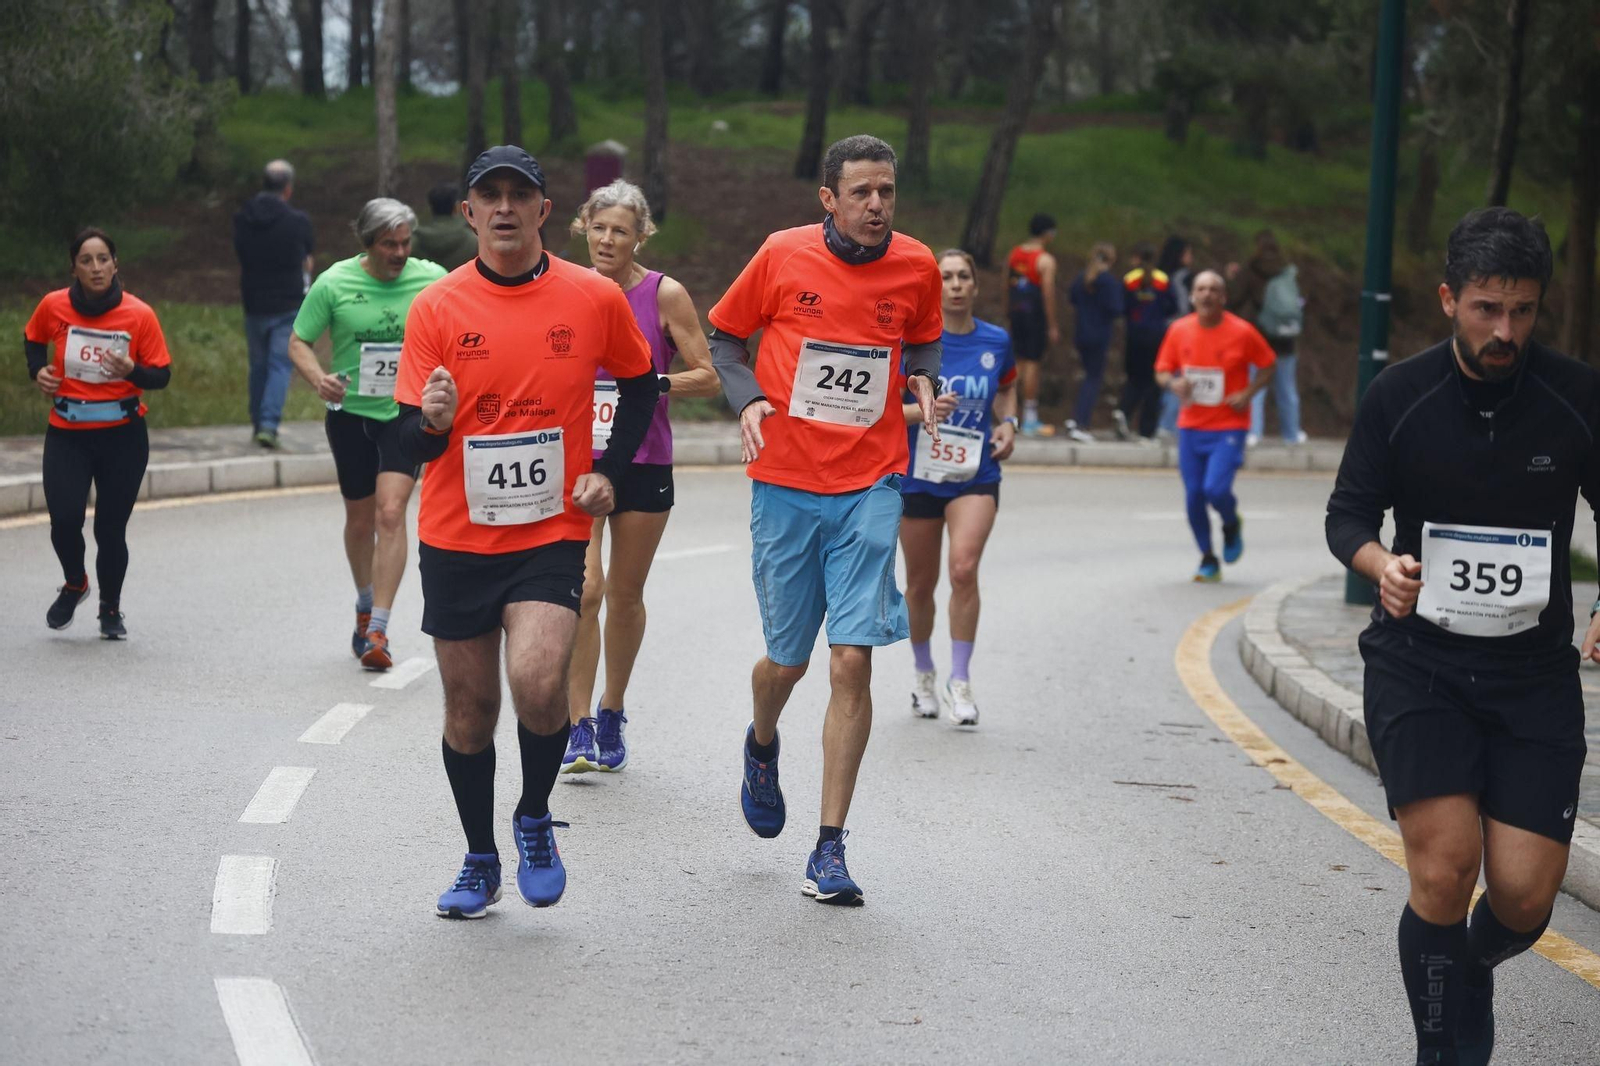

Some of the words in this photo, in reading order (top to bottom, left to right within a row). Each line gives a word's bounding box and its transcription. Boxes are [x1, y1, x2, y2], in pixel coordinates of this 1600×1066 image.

[794, 306, 823, 314] HYUNDAI
[80, 345, 103, 363] 65
[375, 361, 398, 376] 25
[816, 365, 871, 395] 242
[506, 397, 542, 408] Ciudad
[504, 410, 516, 418] de
[520, 407, 555, 417] Málaga
[930, 442, 966, 464] 553
[488, 458, 546, 489] 416
[1450, 559, 1522, 596] 359
[1457, 609, 1484, 617] MARATÓN
